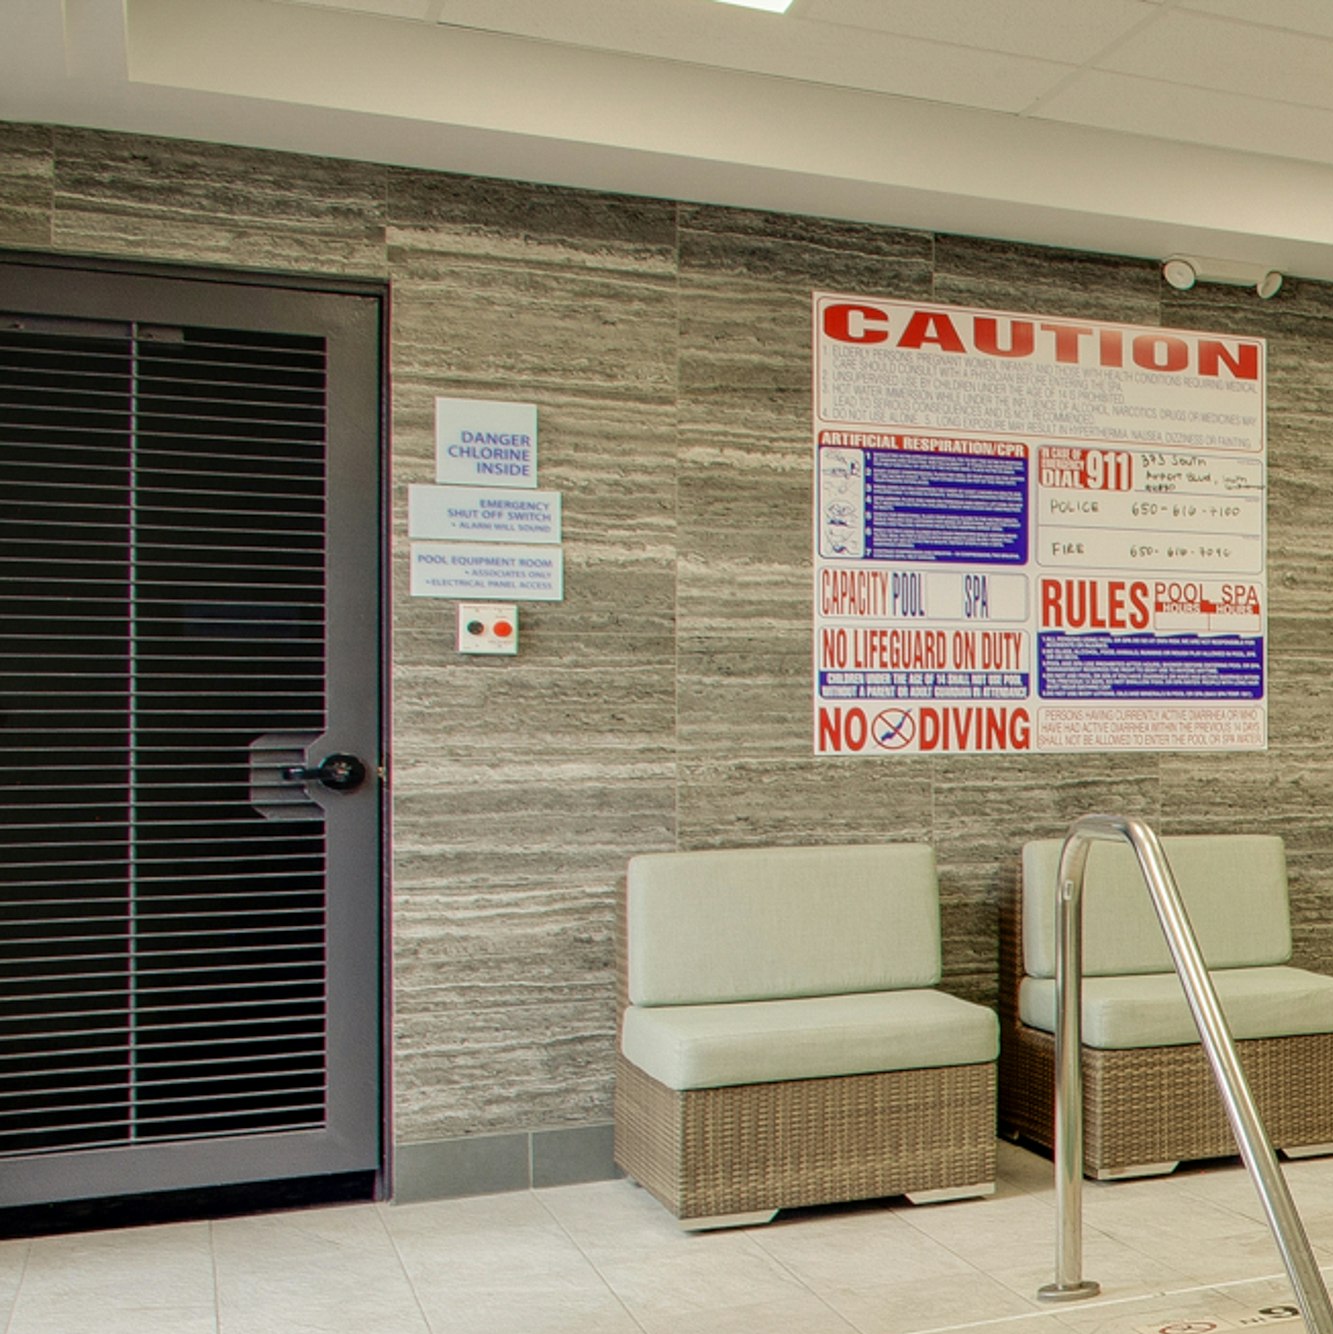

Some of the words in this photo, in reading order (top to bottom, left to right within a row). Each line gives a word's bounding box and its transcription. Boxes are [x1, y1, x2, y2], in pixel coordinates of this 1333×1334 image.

[823, 304, 1258, 380] CAUTION
[461, 431, 531, 447] DANGER
[822, 432, 898, 449] ARTIFICIAL
[903, 437, 1025, 457] RESPIRATION/CPR
[448, 445, 530, 462] CHLORINE
[477, 463, 530, 476] INSIDE
[1042, 469, 1084, 488] DIAL
[1087, 450, 1130, 490] 911
[480, 500, 549, 511] EMERGENCY
[1050, 499, 1099, 514] POLICE
[448, 509, 478, 519] SHUT
[481, 510, 503, 519] OFF
[507, 512, 550, 521] SWITCH
[459, 522, 492, 530] ALARM
[494, 523, 515, 531] WILL
[518, 524, 550, 533] SOUND
[1051, 542, 1085, 555] FIRE
[417, 554, 449, 564] POOL
[451, 556, 516, 566] EQUIPMENT
[519, 559, 553, 568] ROOM
[471, 569, 526, 578] ASSOCIATES
[528, 570, 551, 578] ONLY
[431, 578, 486, 588] ELECTRICAL
[822, 569, 889, 616] CAPACITY
[893, 572, 925, 617] POOL
[964, 574, 989, 618] SPA
[1041, 578, 1150, 630] RULES
[1154, 582, 1208, 603] POOL
[1221, 584, 1260, 606] SPA
[823, 628, 847, 669] NO
[853, 629, 947, 670] LIFEGUARD
[953, 630, 976, 670] ON
[981, 631, 1022, 670] DUTY
[818, 707, 868, 752] NO
[919, 707, 1030, 751] DIVING
